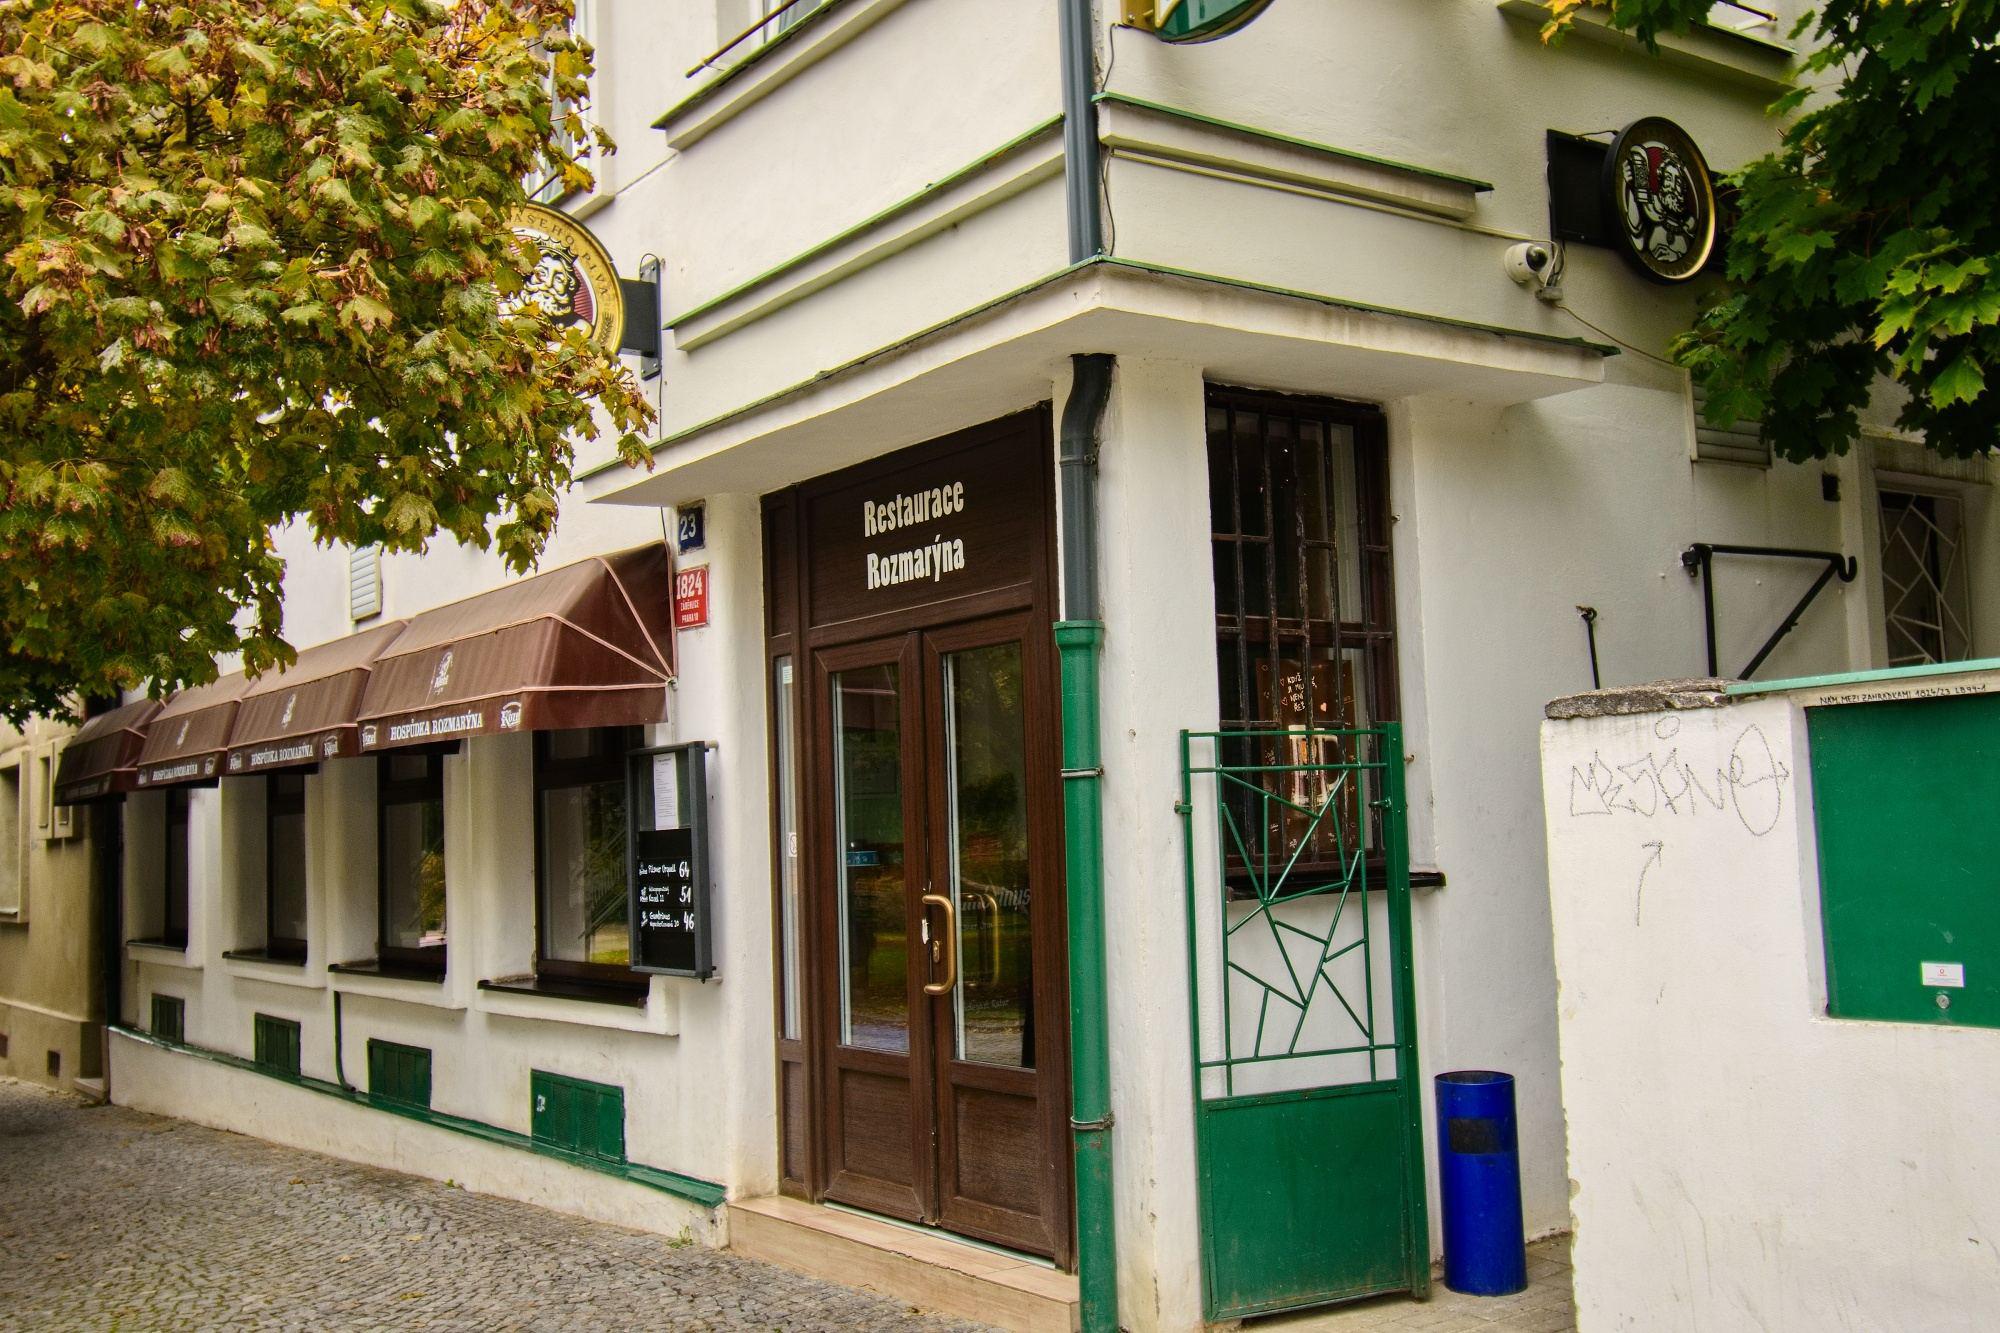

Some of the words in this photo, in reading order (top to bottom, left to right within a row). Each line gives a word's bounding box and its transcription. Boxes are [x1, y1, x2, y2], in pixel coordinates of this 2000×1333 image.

[581, 252, 609, 296] PIVA
[864, 481, 964, 538] Restaurace
[680, 513, 697, 540] 23
[866, 533, 965, 590] Rozmarýna
[676, 571, 703, 600] 1824
[390, 719, 431, 741] HOSPŮDKA
[431, 710, 483, 735] ROZMARÝNA
[679, 861, 690, 878] 64
[679, 885, 692, 903] 51
[683, 911, 695, 932] 46
